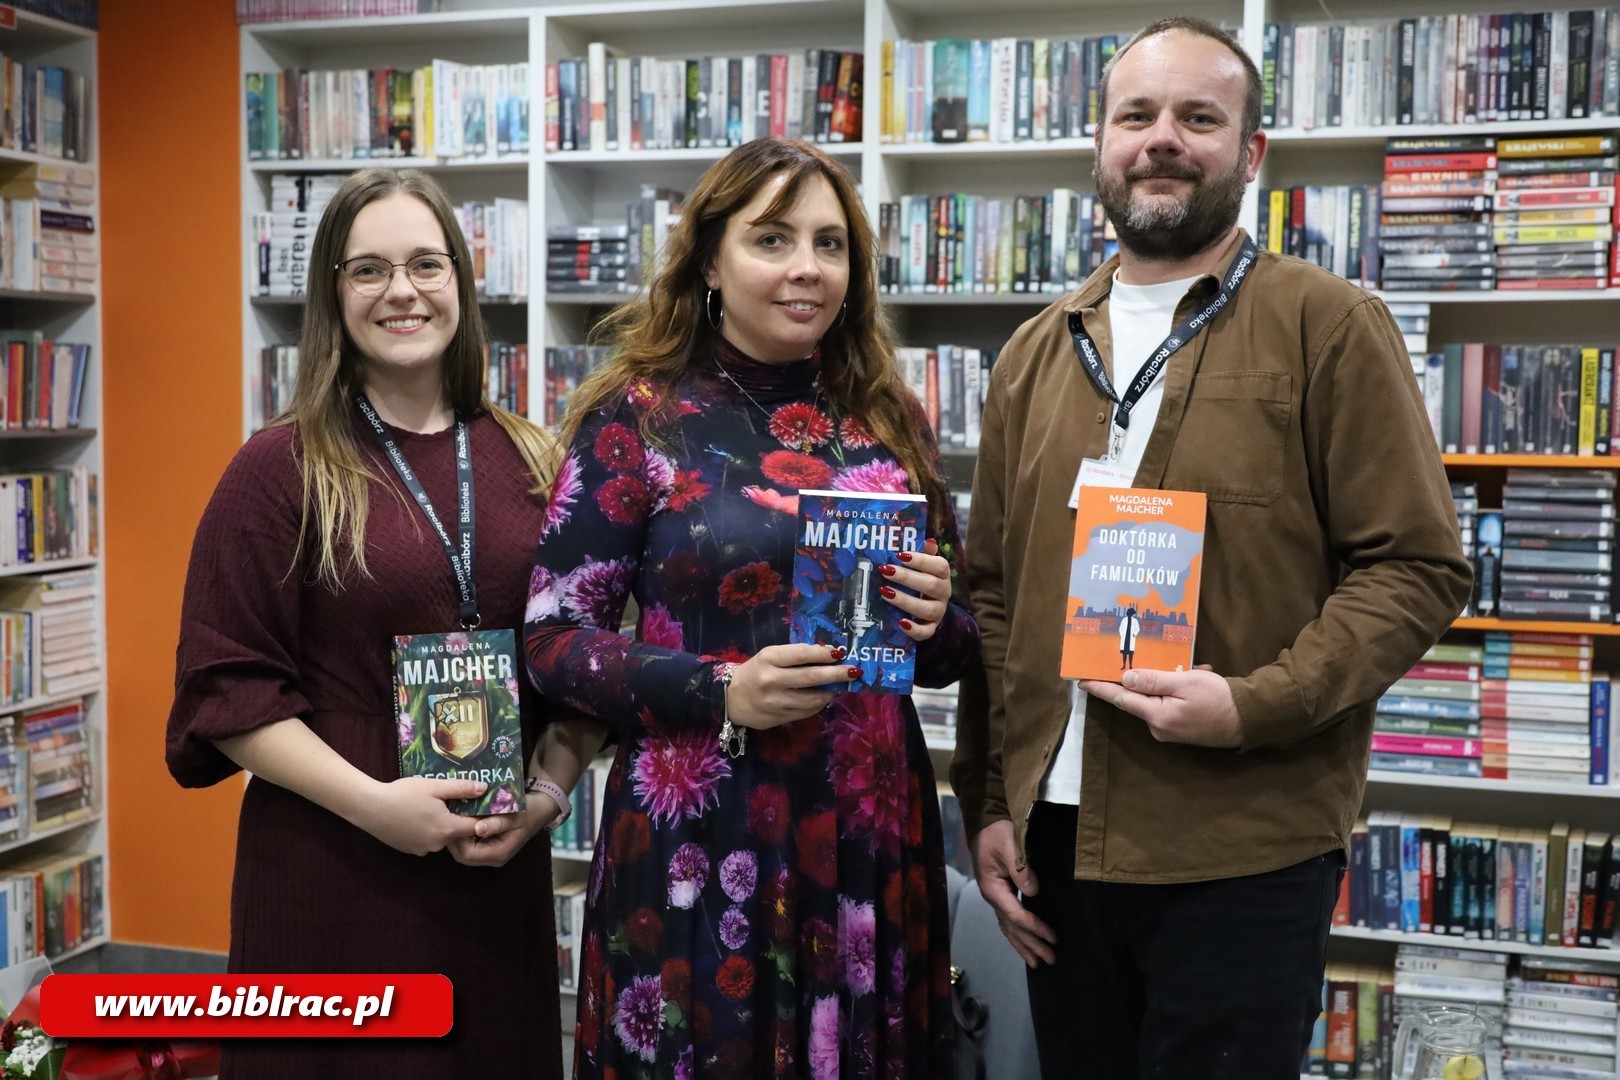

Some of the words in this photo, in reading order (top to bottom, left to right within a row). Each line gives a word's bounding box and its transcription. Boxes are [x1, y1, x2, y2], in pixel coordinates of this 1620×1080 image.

[1228, 257, 1251, 290] Racibórz
[1189, 293, 1228, 329] Biblioteka
[1079, 338, 1098, 370] Racibórz
[1134, 347, 1170, 393] Racibórz
[356, 395, 384, 434] Racibórz
[385, 440, 413, 481] Biblioteka
[458, 421, 466, 459] Racibórz
[461, 481, 470, 523] Biblioteka
[826, 509, 899, 521] MAGDALENA
[1109, 494, 1173, 507] MAGDALENA
[1116, 504, 1164, 515] MAJCHER
[424, 503, 451, 547] Racibórz
[451, 555, 470, 601] Biblioteka
[804, 521, 918, 552] MAJCHER
[1099, 528, 1177, 549] DOKTÓRKA
[461, 532, 471, 580] acibórz
[1126, 548, 1146, 565] OD
[1090, 564, 1179, 586] FAMILOKÓW
[421, 642, 491, 654] MAGDALENA
[825, 644, 906, 664] CASTER
[403, 654, 513, 686] MAJCHER
[413, 767, 516, 783] HTORKA
